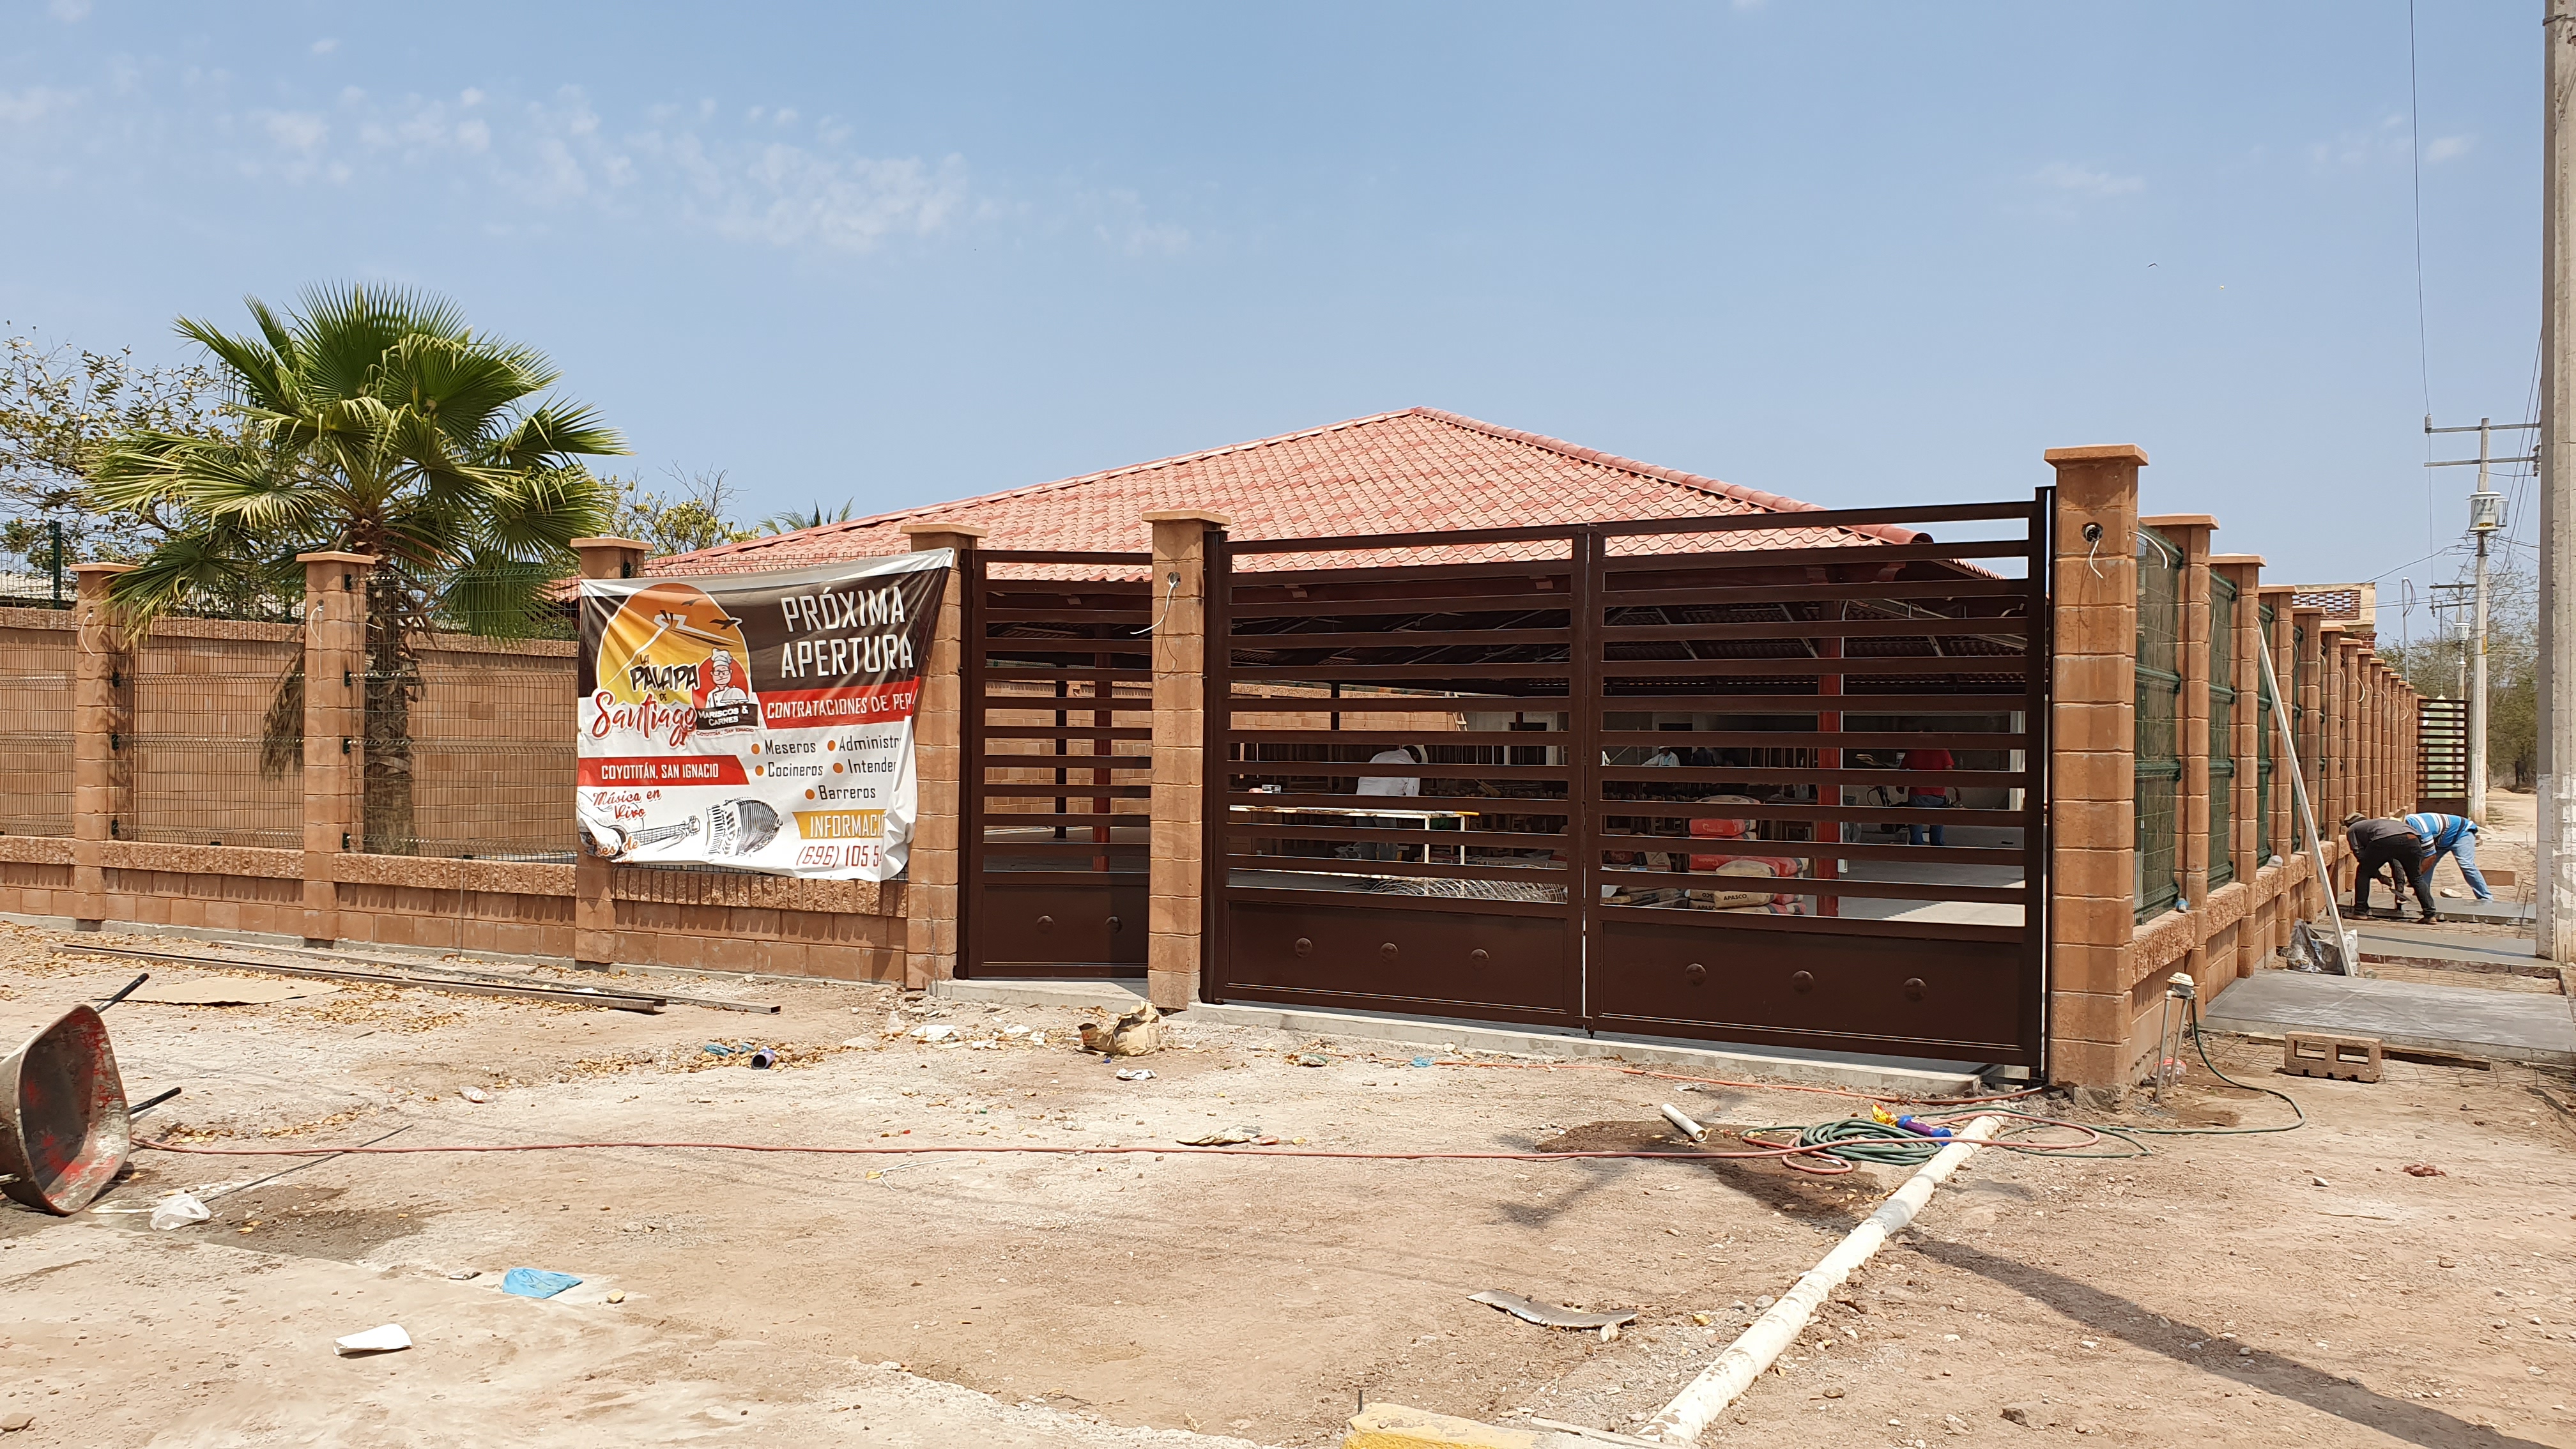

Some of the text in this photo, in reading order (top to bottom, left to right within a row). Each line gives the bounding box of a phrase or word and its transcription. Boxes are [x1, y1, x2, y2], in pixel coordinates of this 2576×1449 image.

[781, 586, 905, 632] PRÓXIMA
[640, 654, 650, 664] LA
[781, 634, 914, 678] APERTURA
[630, 664, 698, 691] PALAPA
[659, 693, 668, 702] DE
[698, 705, 749, 719] MARISCOS &
[767, 697, 868, 719] CONTRATACIONES
[871, 695, 889, 712] DE
[592, 691, 697, 746] Santiago
[709, 716, 739, 726] CARNES
[765, 739, 816, 755] Meseros
[839, 735, 901, 752] Administr
[601, 762, 719, 780] COYOTITÁN, SAN IGNACIO
[768, 762, 824, 778] Cocineros
[593, 789, 662, 806] Música en
[818, 785, 876, 801] Barreros
[615, 805, 645, 820] Vivo
[624, 836, 638, 852] de
[796, 845, 840, 868] (696)
[845, 845, 868, 867] 105
